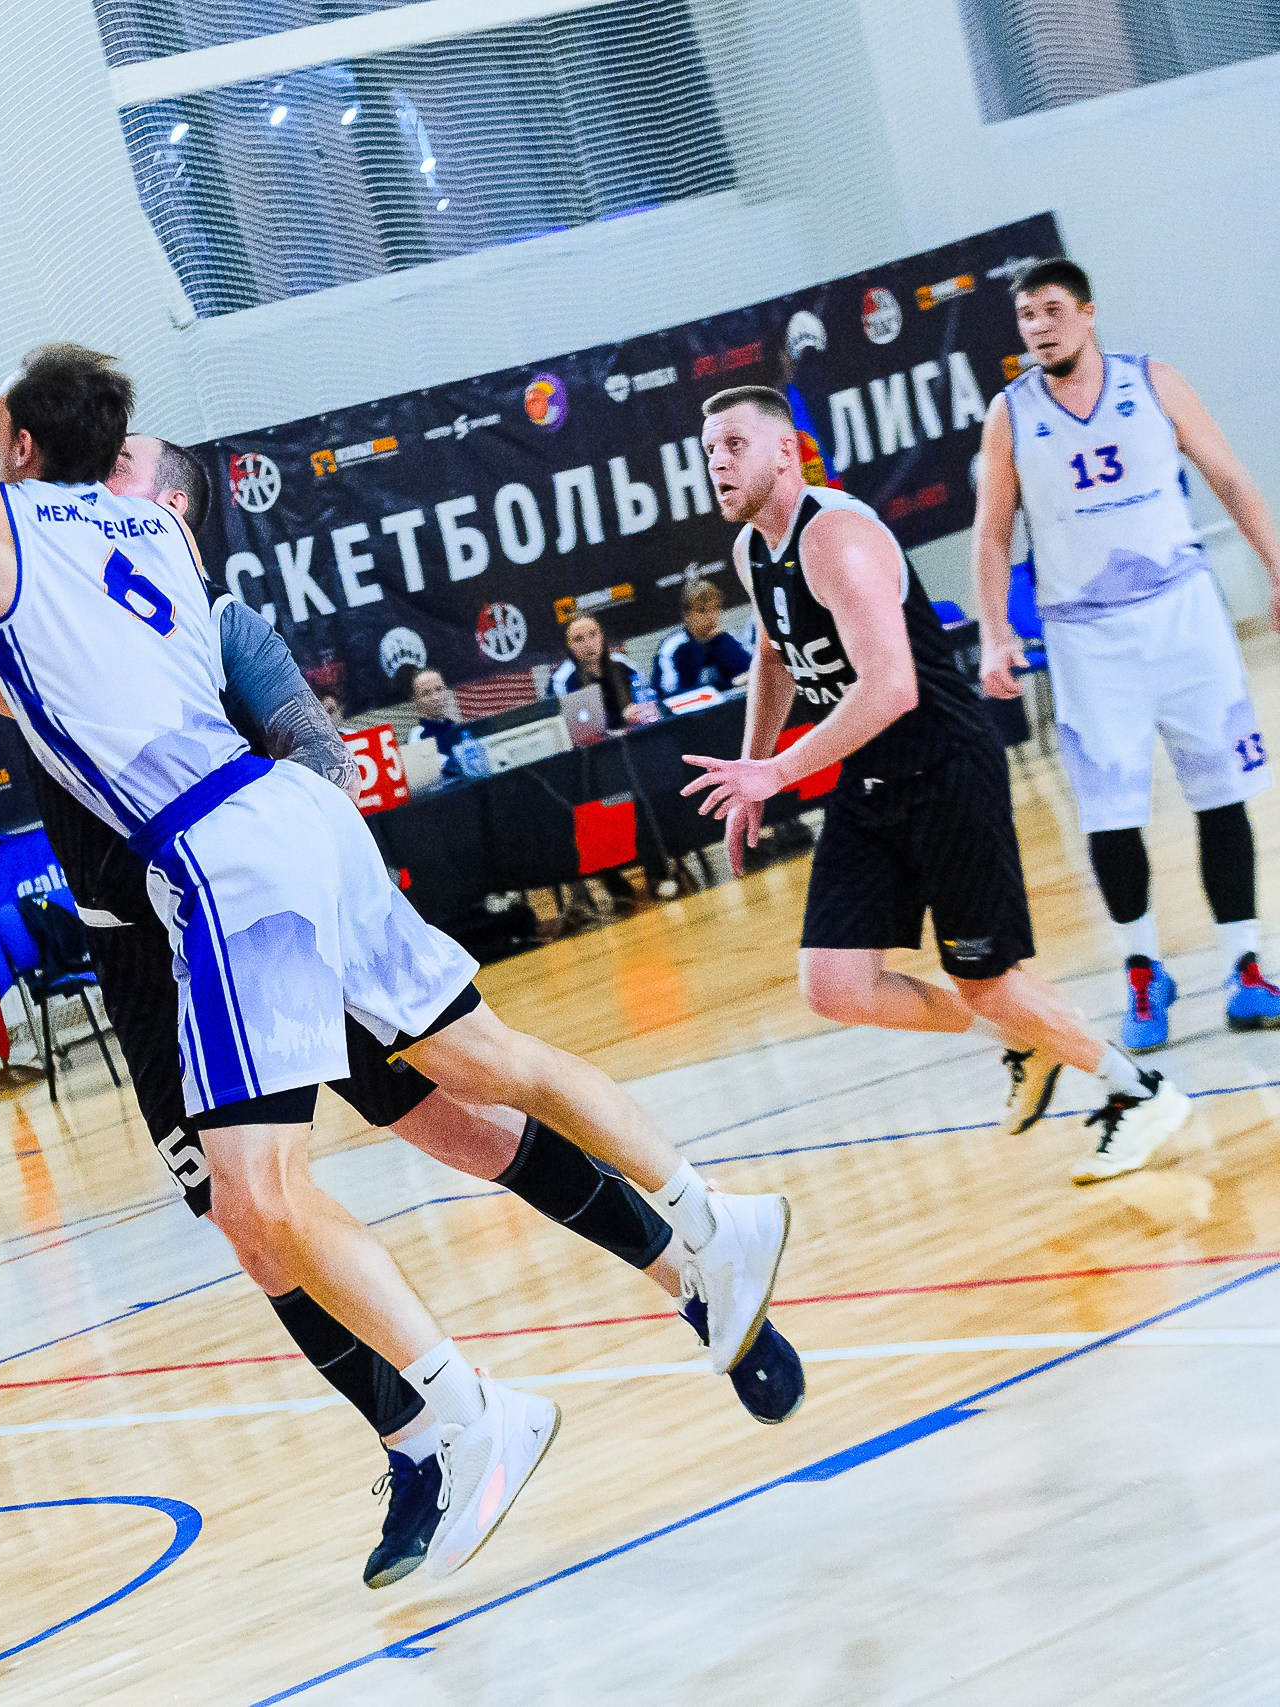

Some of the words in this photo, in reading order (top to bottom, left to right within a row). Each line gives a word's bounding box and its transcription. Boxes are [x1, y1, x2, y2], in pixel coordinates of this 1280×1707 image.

[829, 350, 987, 474] ЛИГА
[1069, 443, 1124, 491] 13
[100, 545, 178, 638] 6
[157, 1125, 211, 1188] 5
